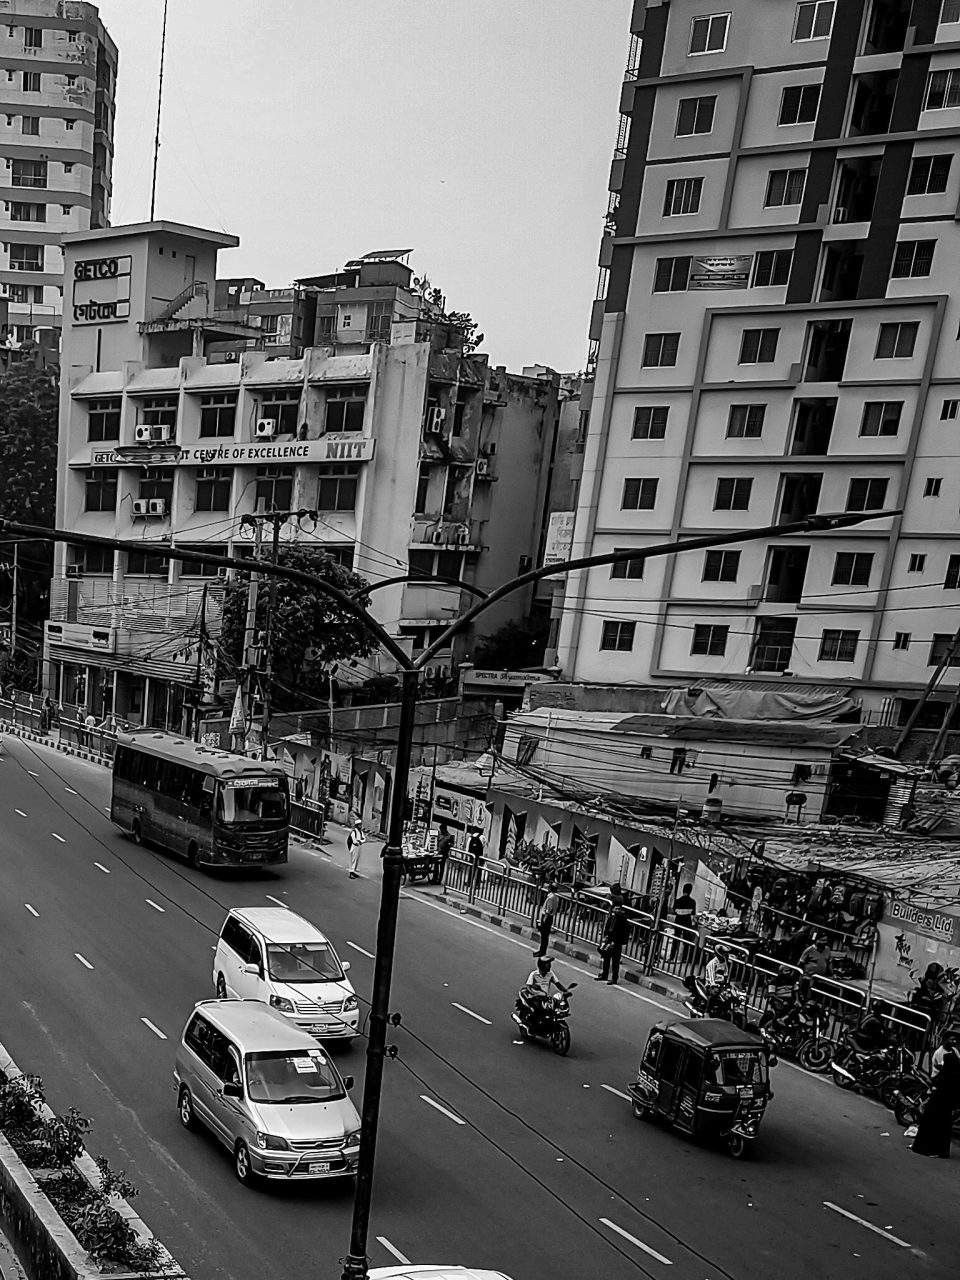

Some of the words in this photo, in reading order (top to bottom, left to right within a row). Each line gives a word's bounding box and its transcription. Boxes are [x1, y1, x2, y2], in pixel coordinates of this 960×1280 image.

[74, 260, 119, 280] GETCO
[193, 449, 230, 459] CENTRE
[232, 449, 245, 459] OF
[247, 446, 309, 459] EXCELLENCE
[325, 442, 366, 459] NIIT
[891, 902, 933, 927] Builders
[933, 915, 953, 934] Ltd.
